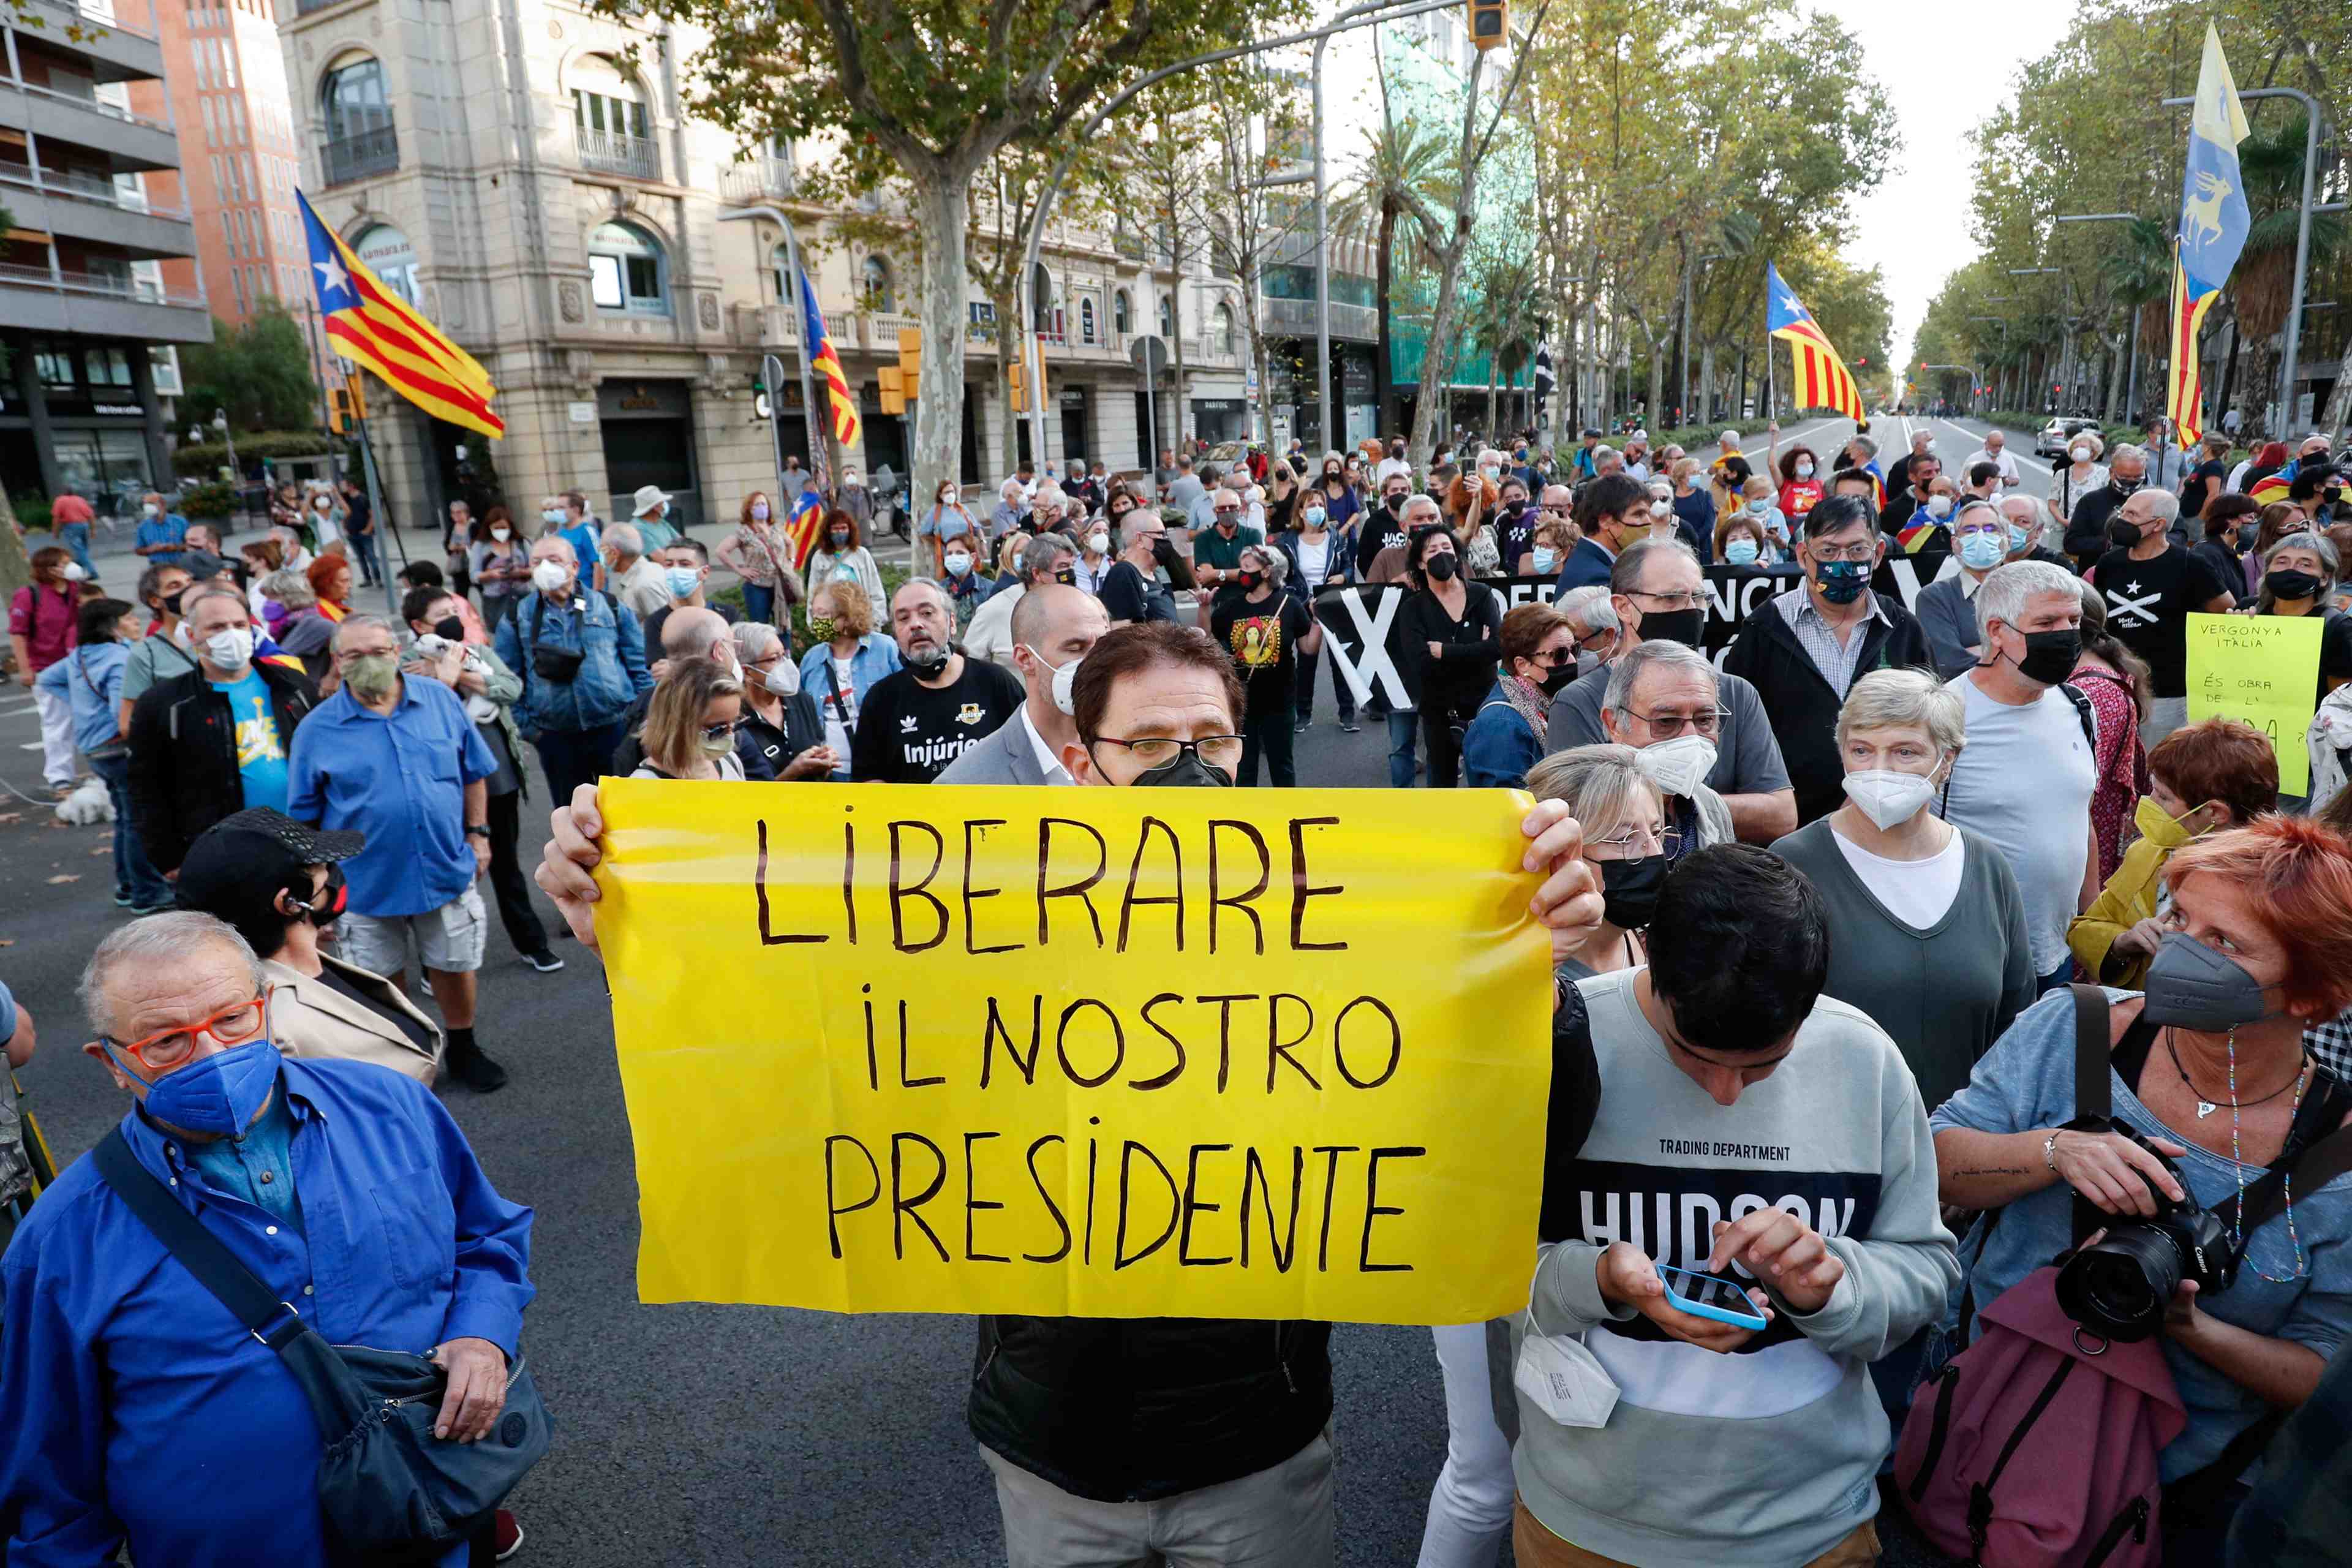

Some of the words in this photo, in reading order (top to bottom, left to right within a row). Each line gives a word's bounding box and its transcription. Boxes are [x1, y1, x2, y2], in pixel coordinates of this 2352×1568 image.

[1382, 532, 1407, 543] JAC
[2200, 624, 2282, 635] VERGONYA
[2204, 673, 2223, 687] ÉS
[2237, 680, 2271, 690] OBRA
[980, 993, 1400, 1094] NOSTRO
[1659, 1139, 1709, 1155] TRADING
[1713, 1142, 1790, 1161] DEPARTMENT
